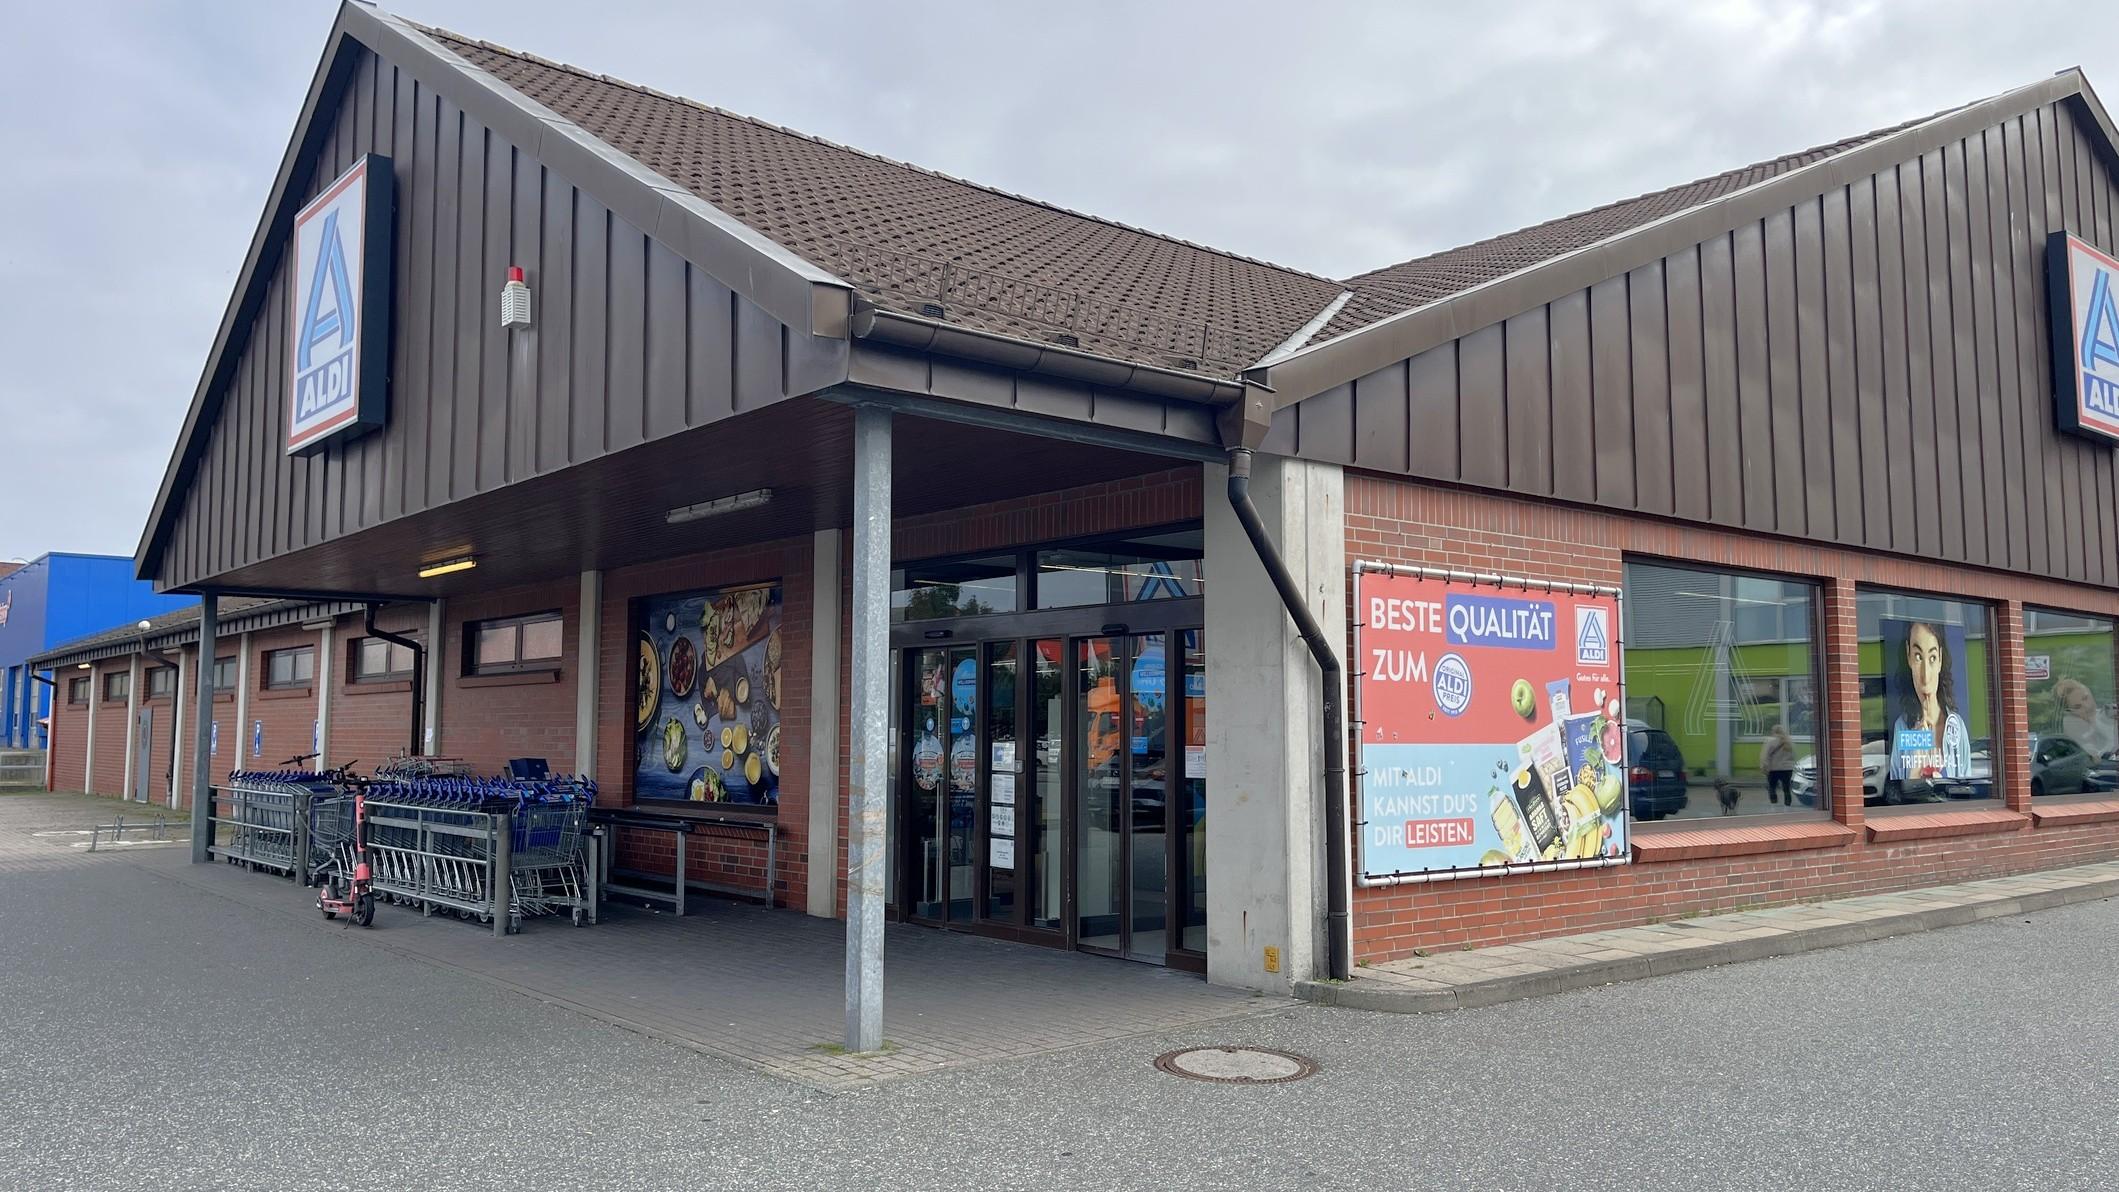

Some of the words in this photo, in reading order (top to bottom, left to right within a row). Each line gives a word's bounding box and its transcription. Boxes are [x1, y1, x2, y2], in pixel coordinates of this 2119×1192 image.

[300, 356, 349, 417] ALDI
[2089, 377, 2119, 414] AL
[1371, 597, 1442, 633] BESTE
[1450, 603, 1552, 643] QUALITÄT
[1372, 649, 1428, 683] ZUM
[1582, 649, 1604, 661] ALDI
[1437, 674, 1468, 697] ALDI
[1442, 691, 1460, 705] PREIS
[1900, 733, 1932, 747] FRISCHE
[1901, 755, 1926, 768] TRIFFT
[1373, 766, 1401, 787] MIT
[1406, 766, 1441, 786] ALDI
[1374, 795, 1439, 817] KANNST
[1443, 793, 1478, 814] DU'S
[1375, 825, 1402, 846] DIR
[1407, 822, 1472, 845] LEISTEN.
